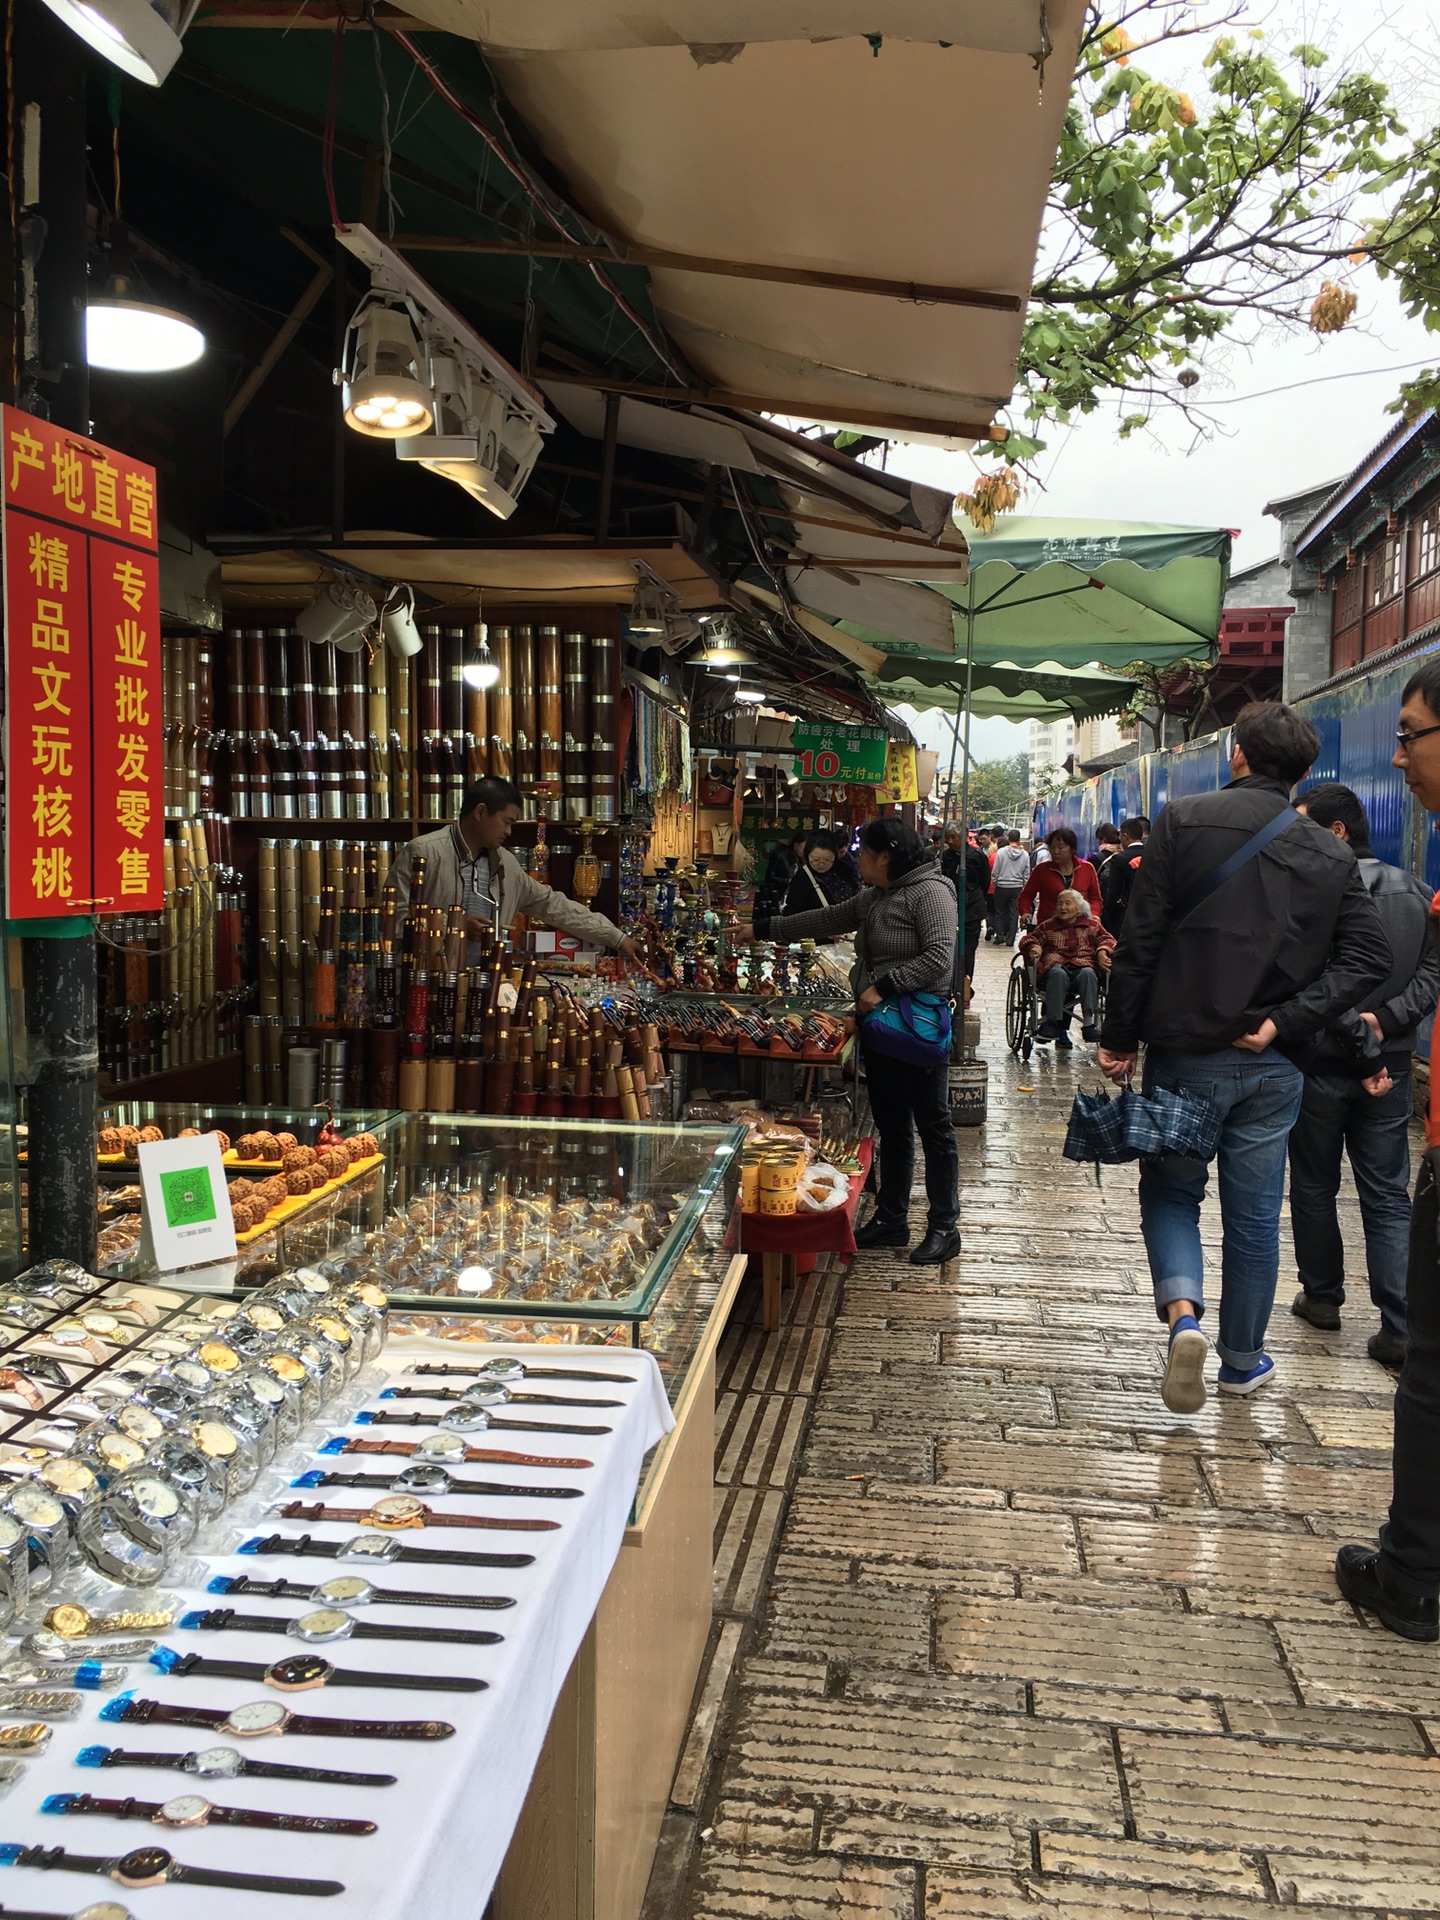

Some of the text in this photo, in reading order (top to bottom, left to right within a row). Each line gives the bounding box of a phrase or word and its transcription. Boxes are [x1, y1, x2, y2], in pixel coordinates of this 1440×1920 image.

[10, 428, 154, 540] 产地直营
[28, 531, 73, 898] 精品文玩核桃
[112, 560, 151, 895] 专业批发零售
[797, 750, 840, 778] 10
[798, 723, 885, 741] 防疲劳老花眼镜
